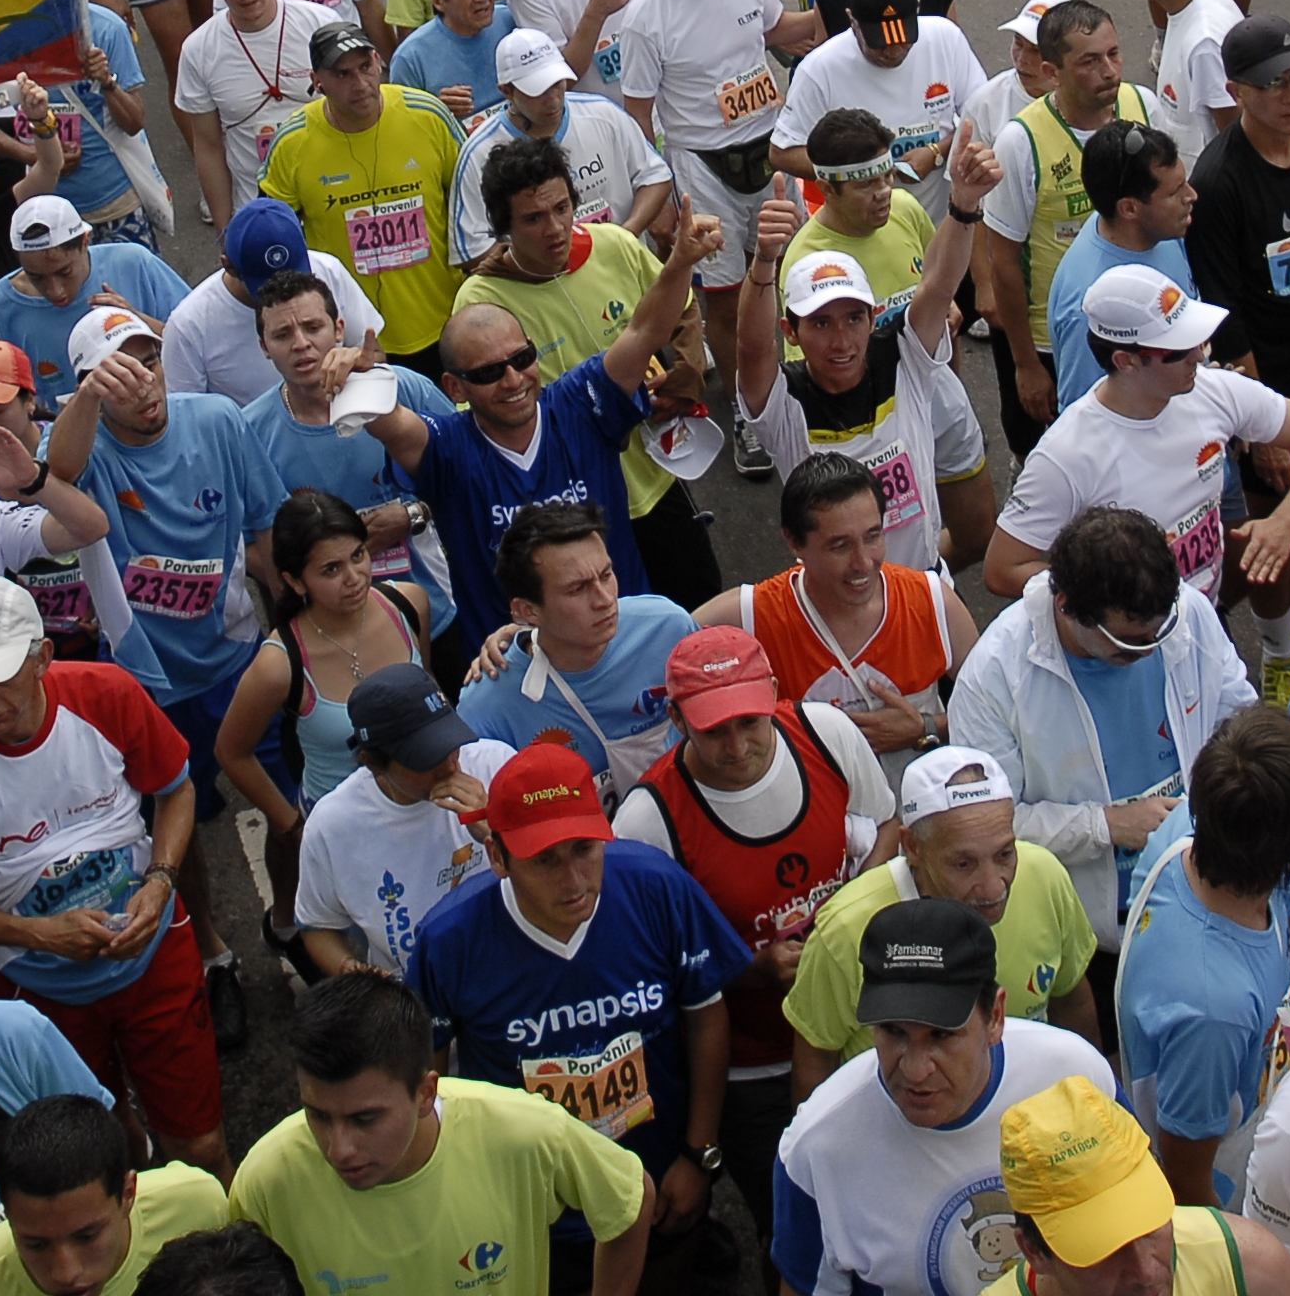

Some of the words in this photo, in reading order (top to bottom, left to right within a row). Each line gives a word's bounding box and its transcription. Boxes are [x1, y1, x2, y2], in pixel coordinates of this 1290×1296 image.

[736, 64, 767, 85] Porvenir
[728, 74, 777, 119] 34703
[898, 122, 934, 137] Porvenir
[339, 181, 420, 206] BODYTECH
[371, 195, 419, 216] Porvenir
[353, 213, 420, 251] 23011
[811, 277, 854, 293] Porvenir
[887, 292, 914, 308] Porve
[1097, 325, 1139, 339] Porvenir
[862, 444, 900, 471] rvenir
[1176, 500, 1220, 534] Porvenir
[28, 570, 83, 587] Porvenir
[163, 559, 217, 575] Porvenir
[35, 587, 82, 617] 627
[128, 572, 215, 612] 23575
[522, 784, 569, 805] synapsis
[951, 787, 991, 801] Porvenir
[31, 849, 116, 912] 39439
[437, 850, 483, 888] Gatorade
[506, 979, 665, 1043] synapsis
[567, 1040, 633, 1076] Porvenir
[1050, 1136, 1099, 1168] ZAPATOCA
[454, 1266, 508, 1291] Carrefour
